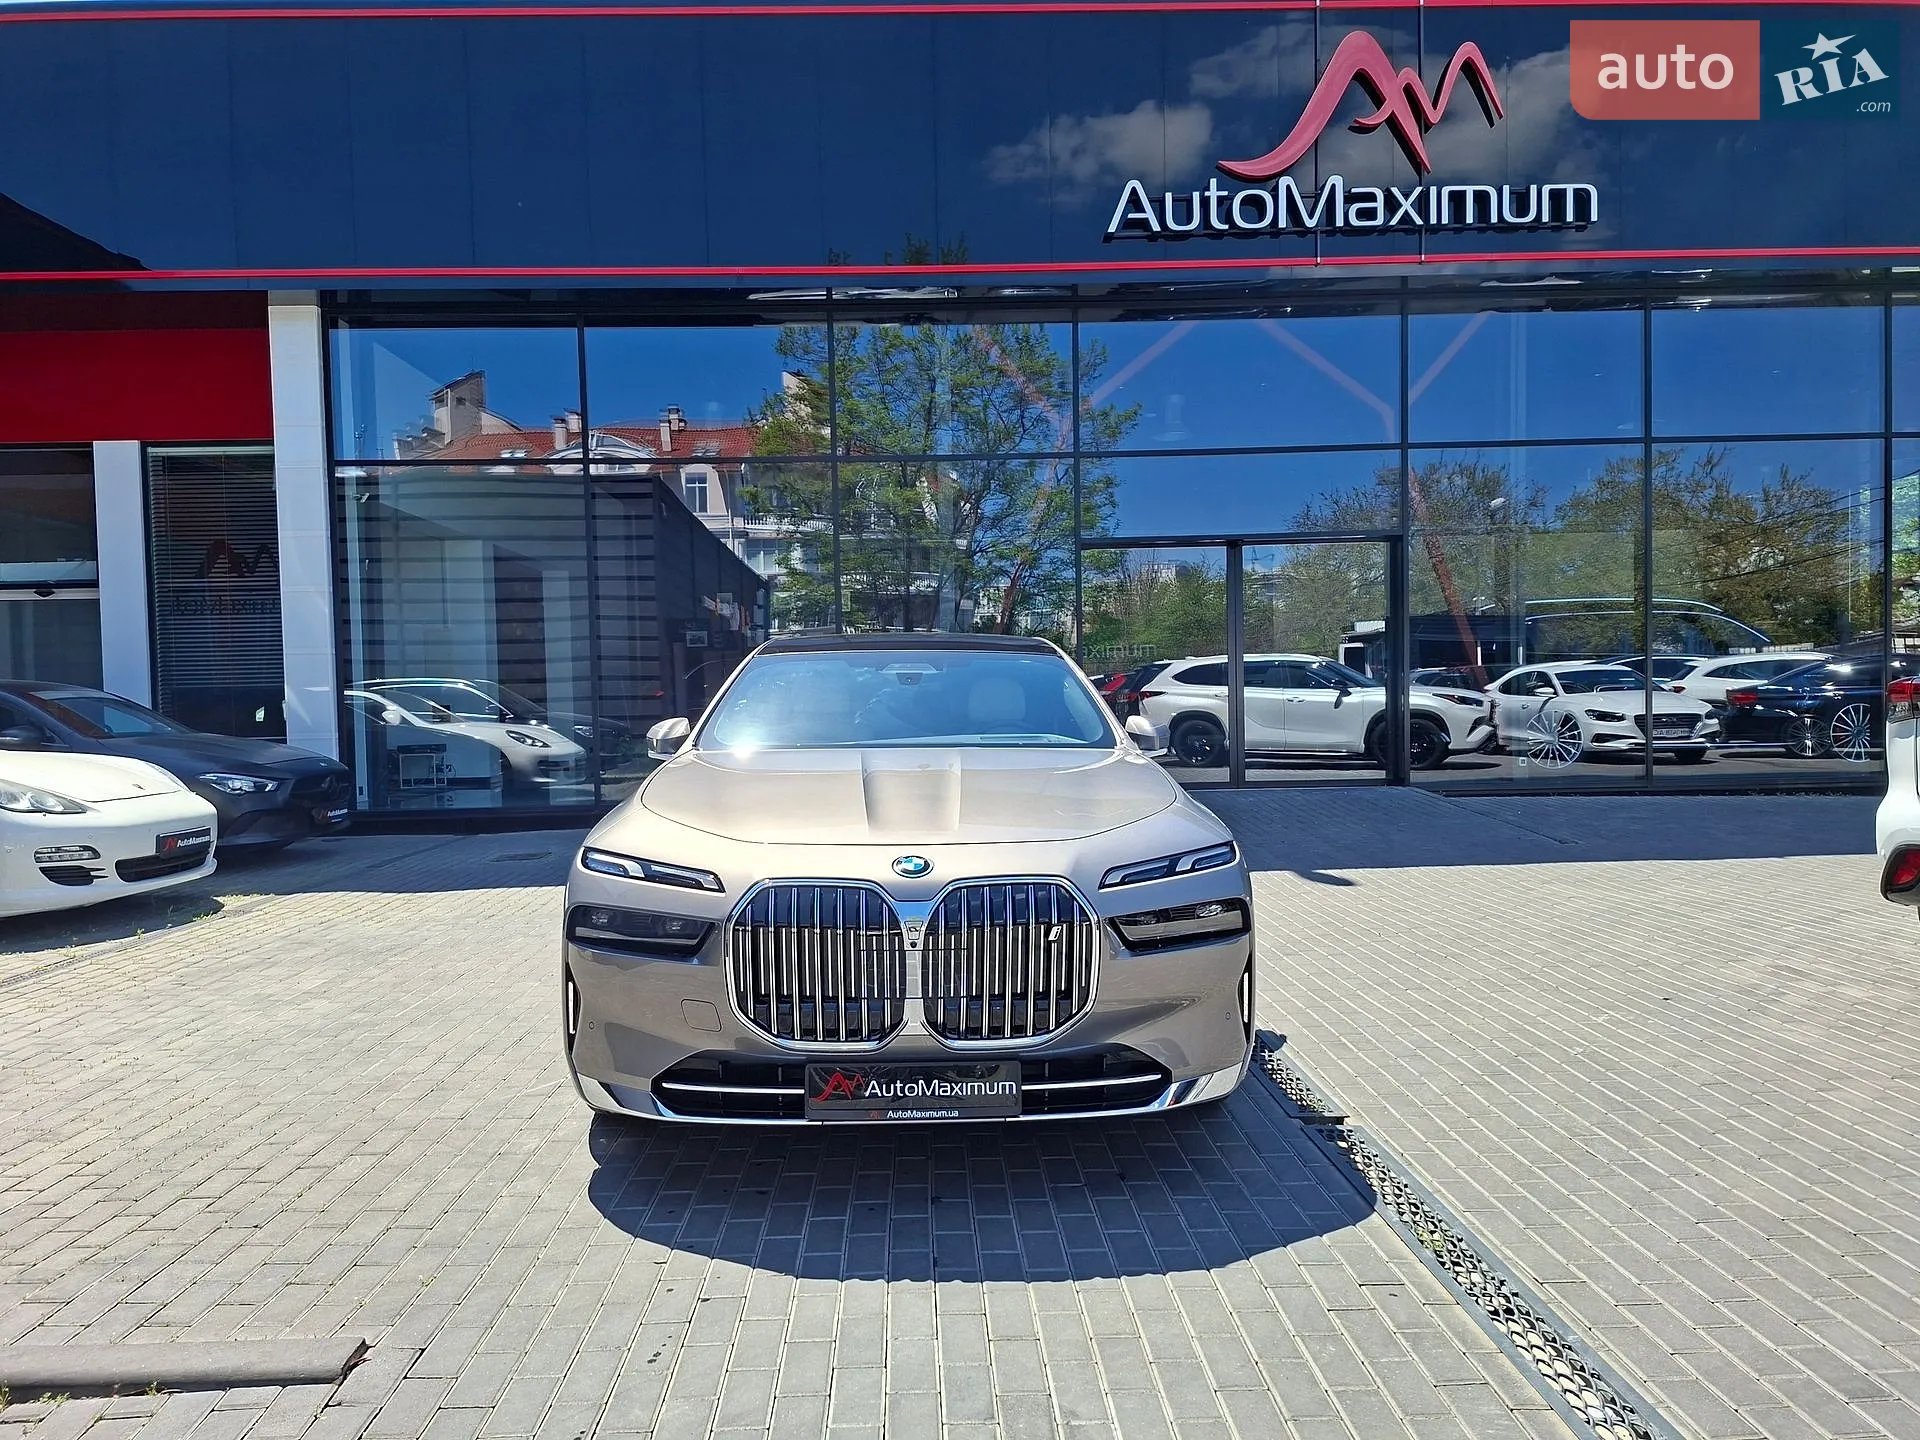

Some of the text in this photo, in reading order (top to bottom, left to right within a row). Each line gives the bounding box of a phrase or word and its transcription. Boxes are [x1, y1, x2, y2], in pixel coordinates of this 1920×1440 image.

[1106, 174, 1600, 234] AutoMaximum
[864, 1079, 1017, 1097] AutoMaximum
[886, 1109, 960, 1119] AutoMaximum.ua
